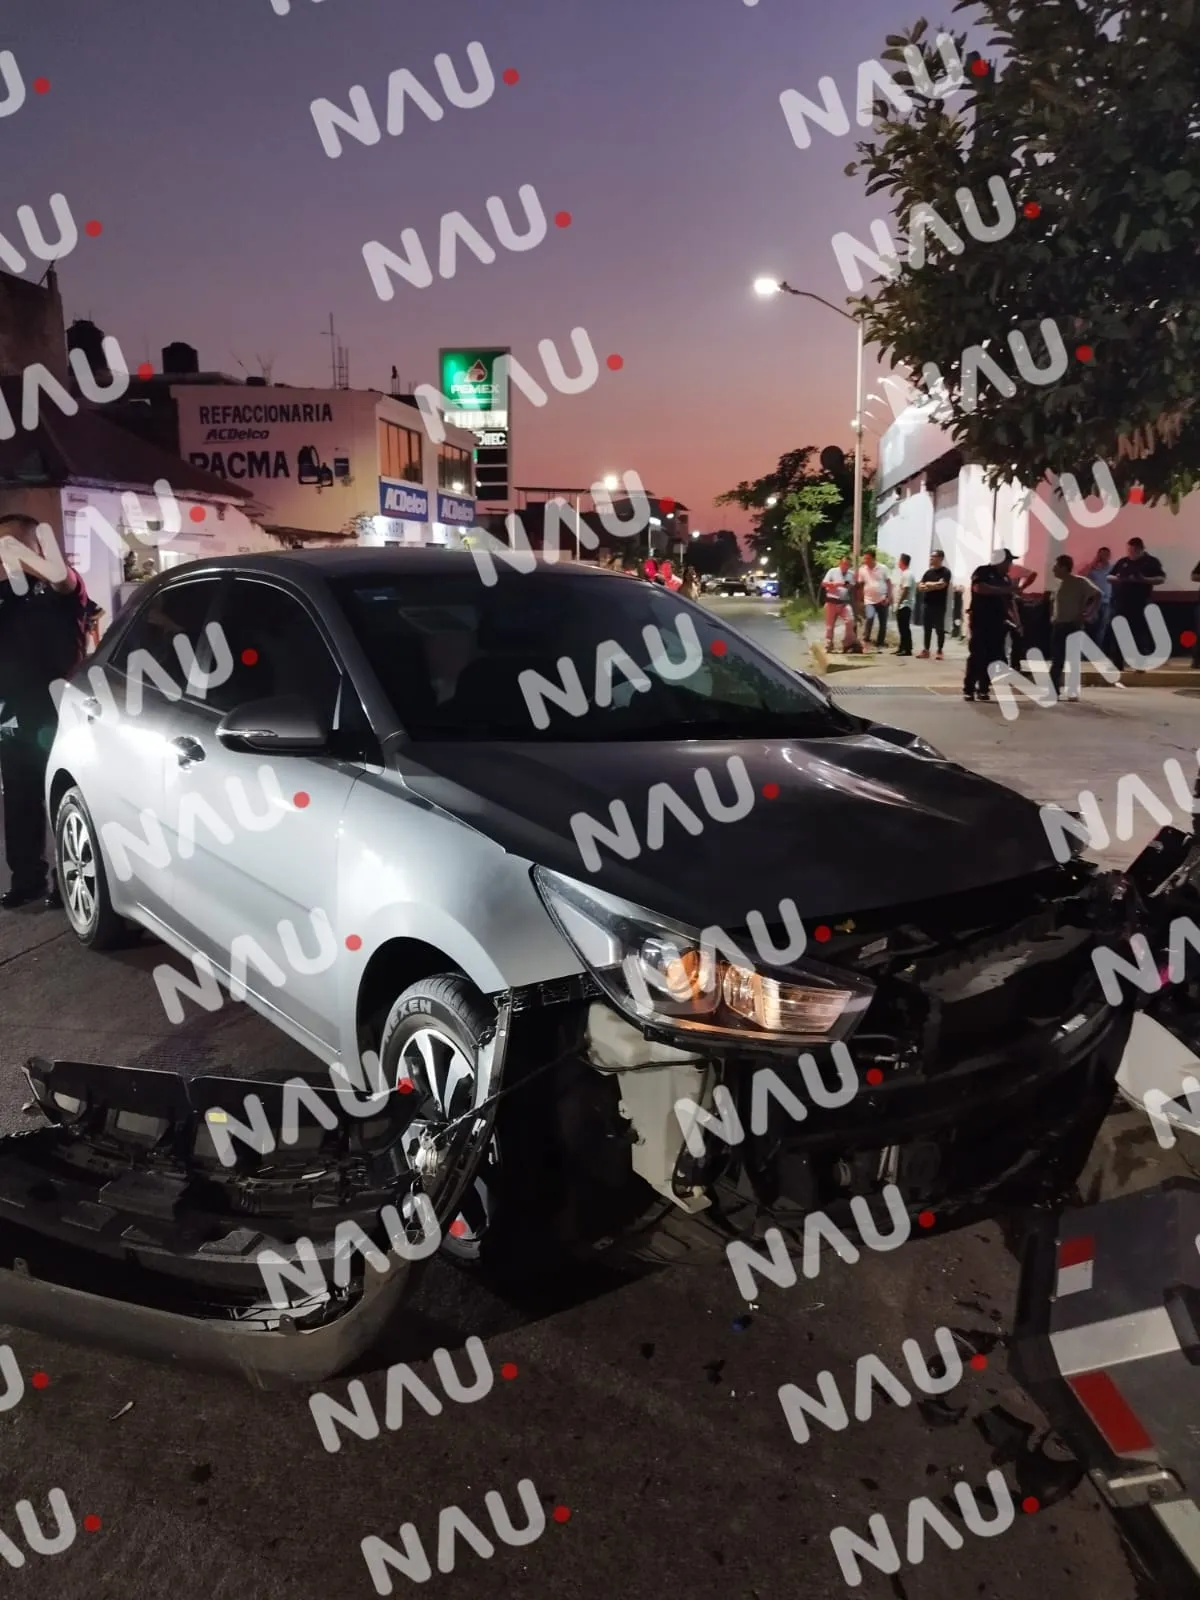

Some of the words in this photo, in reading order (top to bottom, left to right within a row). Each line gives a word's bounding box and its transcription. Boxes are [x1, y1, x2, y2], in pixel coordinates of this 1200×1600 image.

[450, 384, 500, 394] PEMEX
[200, 404, 333, 424] REFACCIONARIA
[206, 428, 270, 441] ACDelco
